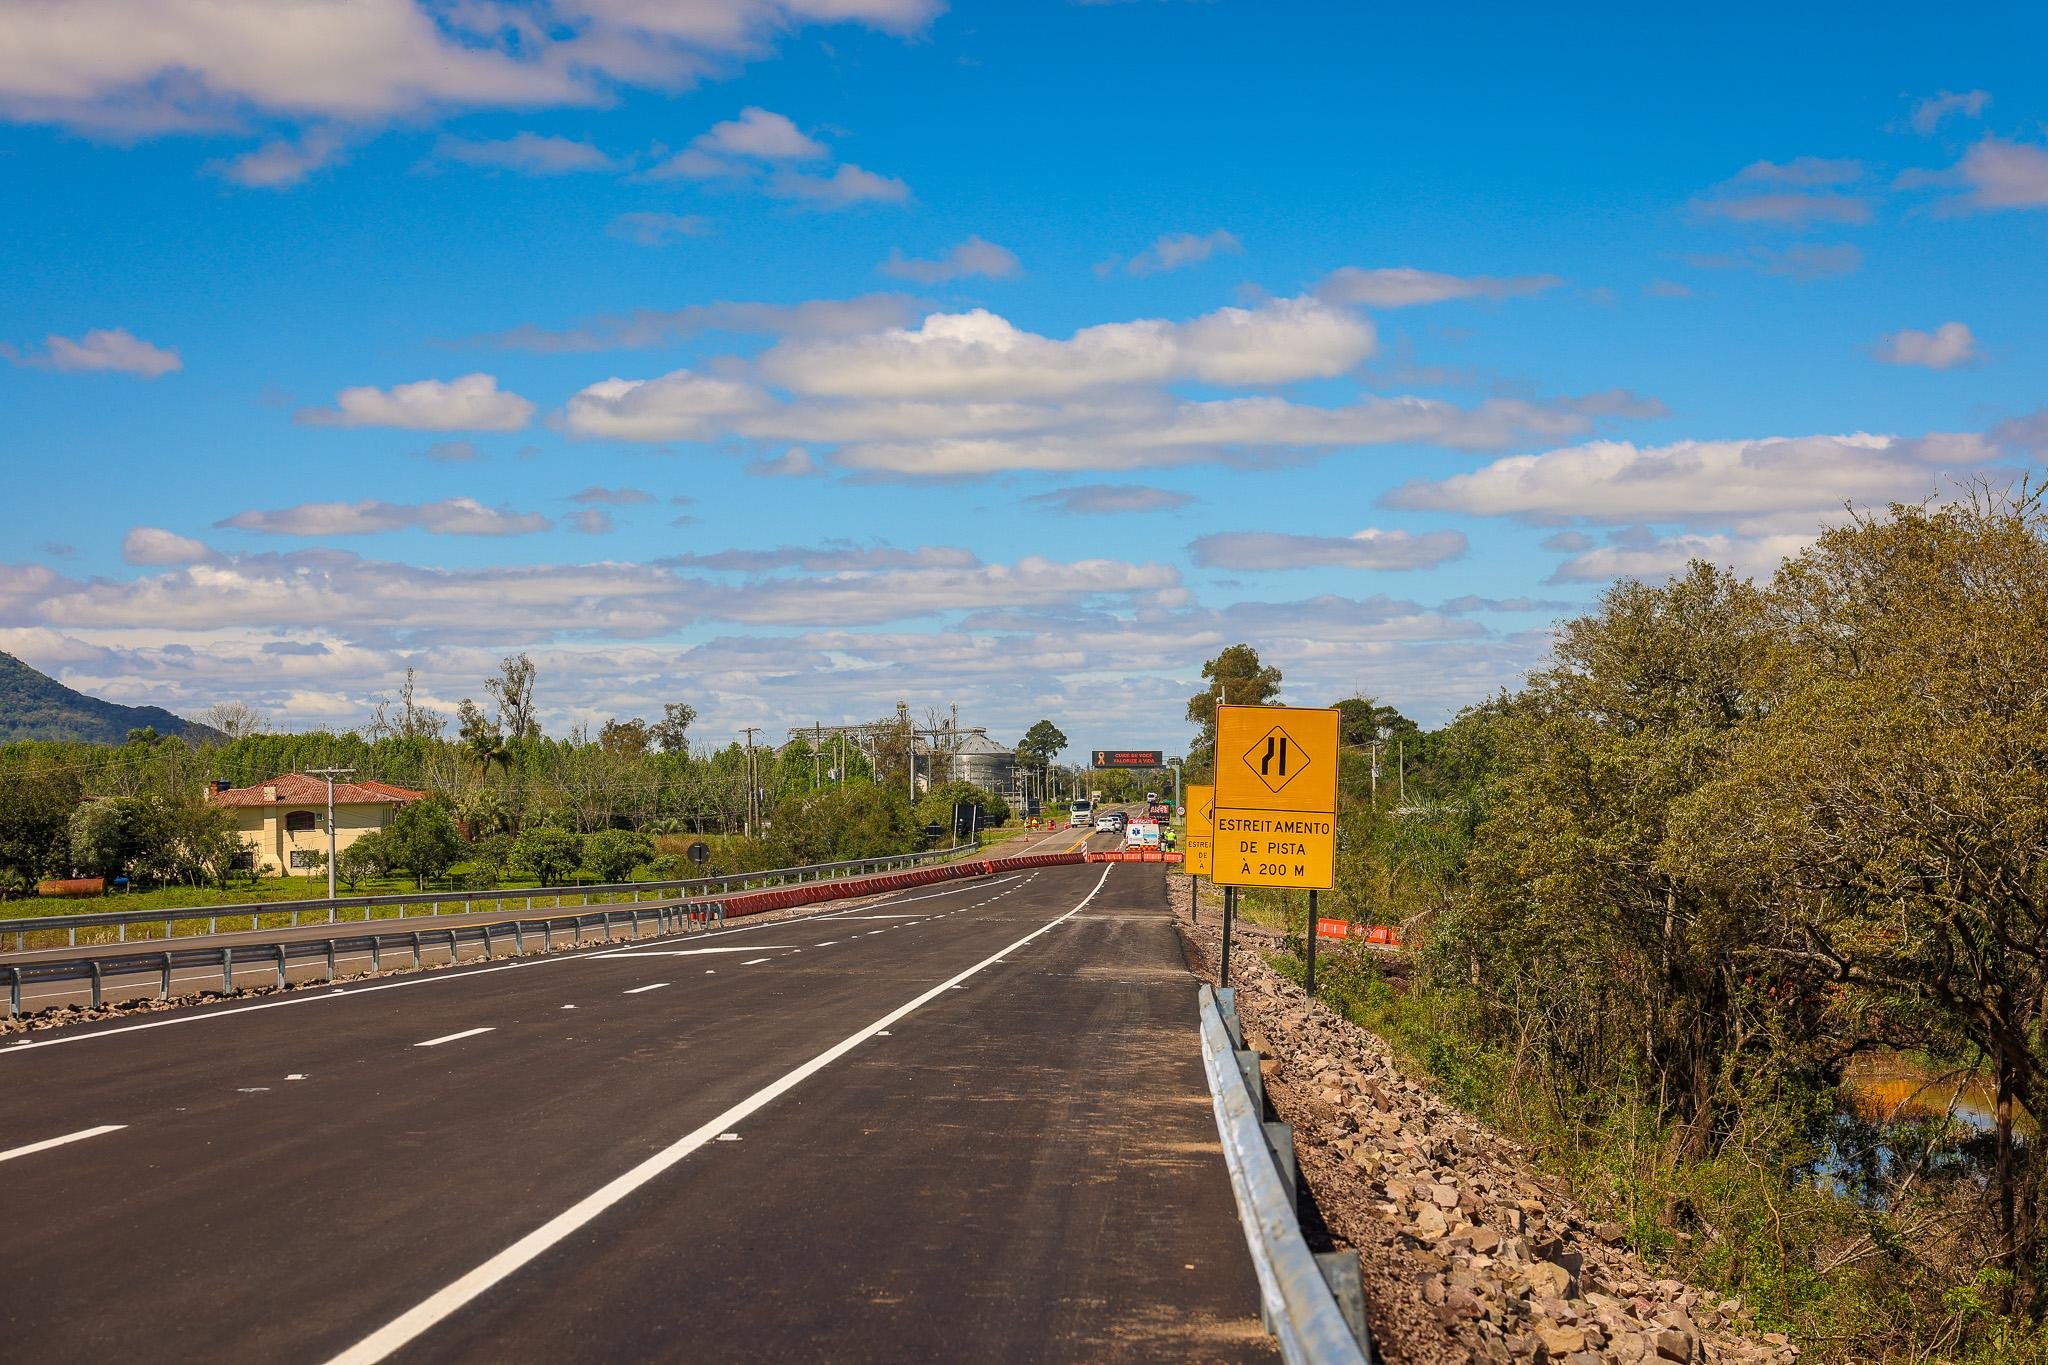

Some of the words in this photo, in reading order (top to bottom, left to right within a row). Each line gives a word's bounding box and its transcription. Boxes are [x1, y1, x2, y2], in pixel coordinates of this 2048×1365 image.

[1219, 819, 1330, 835] ESTREITAMENTO
[1240, 841, 1257, 854] DE
[1268, 842, 1306, 855] PISTA
[1241, 858, 1250, 874] À
[1259, 863, 1287, 876] 200
[1294, 865, 1304, 877] M
